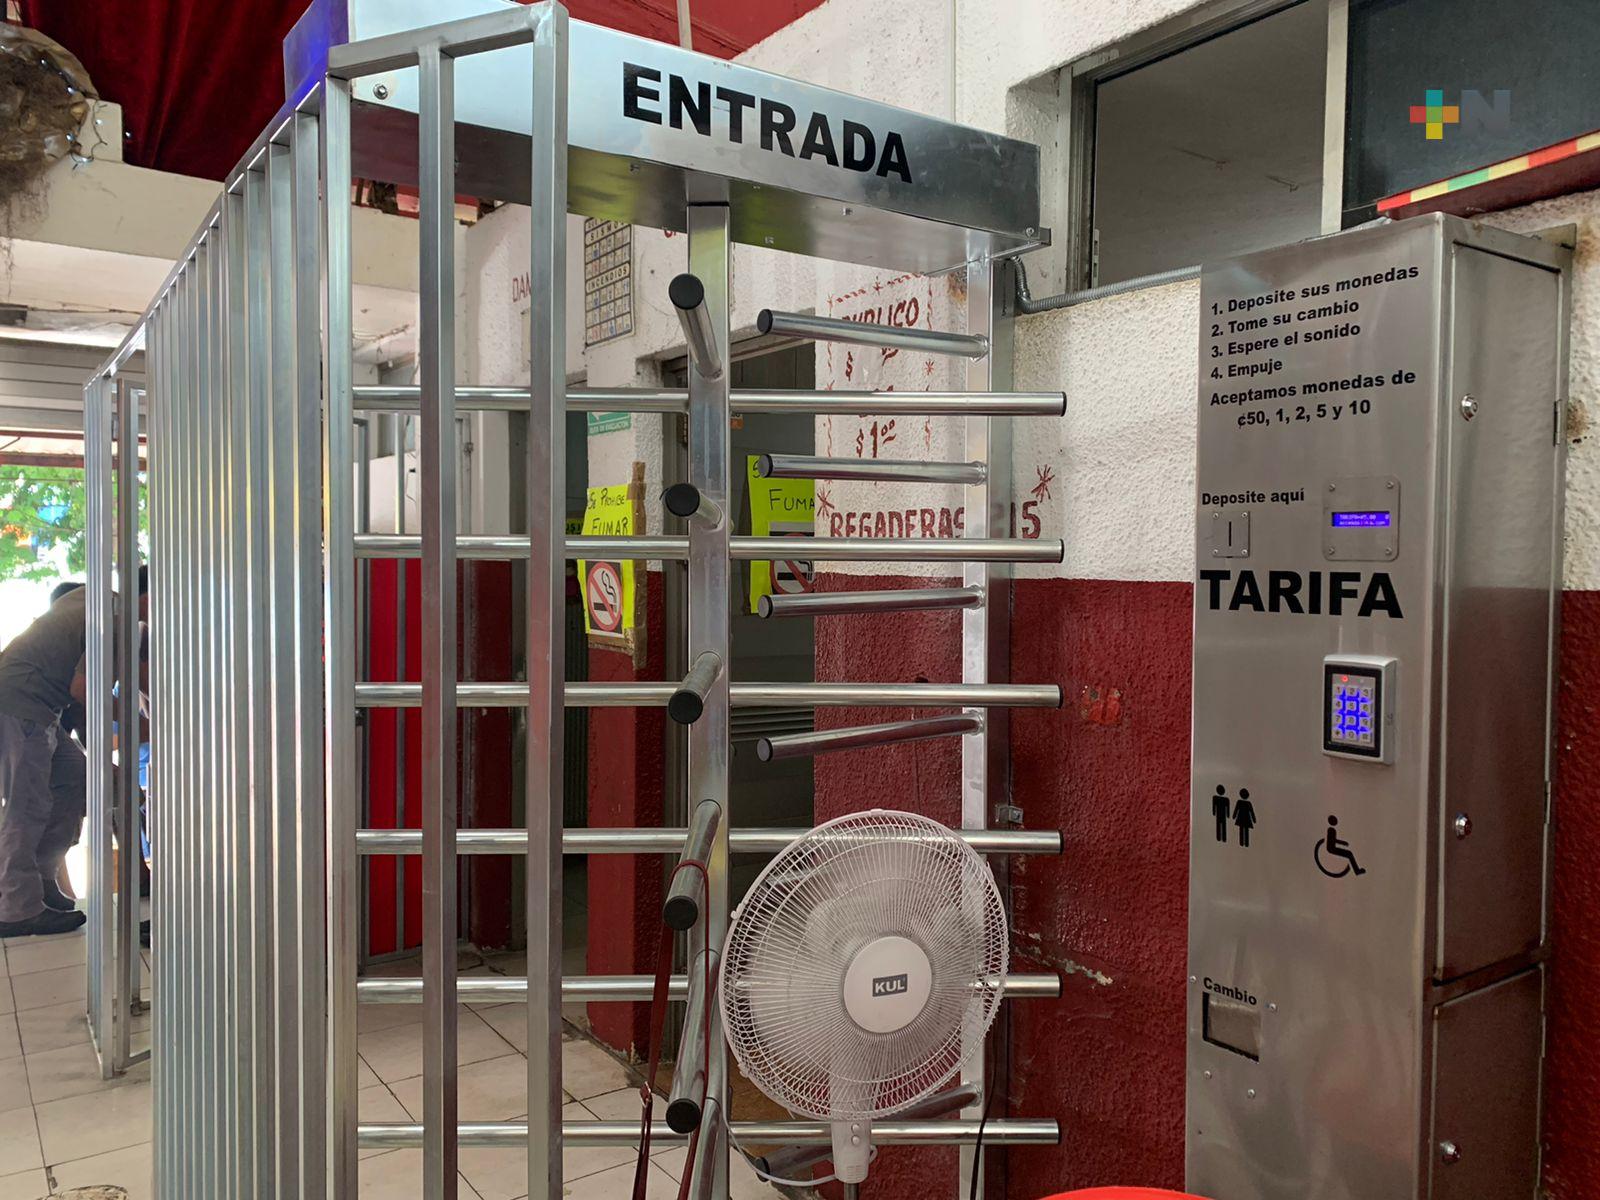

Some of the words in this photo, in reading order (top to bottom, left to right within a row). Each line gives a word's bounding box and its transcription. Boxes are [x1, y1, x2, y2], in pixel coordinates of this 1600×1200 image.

[623, 61, 912, 184] ENTRADA
[590, 217, 624, 241] SISMO
[587, 265, 628, 291] INCENDIOS
[1211, 303, 1223, 315] 1.
[1228, 290, 1295, 312] Deposite
[1301, 283, 1330, 298] sus
[1336, 266, 1419, 292] monedas
[1211, 324, 1223, 337] 2.
[1228, 317, 1268, 334] Tome
[1273, 313, 1291, 325] su
[1297, 300, 1359, 321] cambio
[1211, 345, 1223, 358] 3.
[1228, 337, 1279, 355] Espere
[1284, 331, 1298, 345] el
[1304, 323, 1360, 343] sonido
[1210, 367, 1223, 379] 4.
[1228, 358, 1282, 377] Empuje
[1210, 385, 1297, 405] Aceptamos
[1303, 374, 1385, 395] monedas
[1391, 370, 1416, 384] de
[1276, 408, 1290, 424] 1,
[1295, 406, 1311, 422] 2,
[1316, 404, 1327, 418] 5
[1332, 405, 1342, 420] y
[1349, 400, 1371, 415] 10
[769, 488, 815, 511] FUMA
[1202, 491, 1266, 507] Deposite
[1270, 488, 1305, 505] aquí
[592, 516, 629, 536] FUMAR
[1200, 569, 1404, 619] TARIFA
[875, 980, 905, 993] KUL
[1203, 976, 1257, 1005] Cambio
